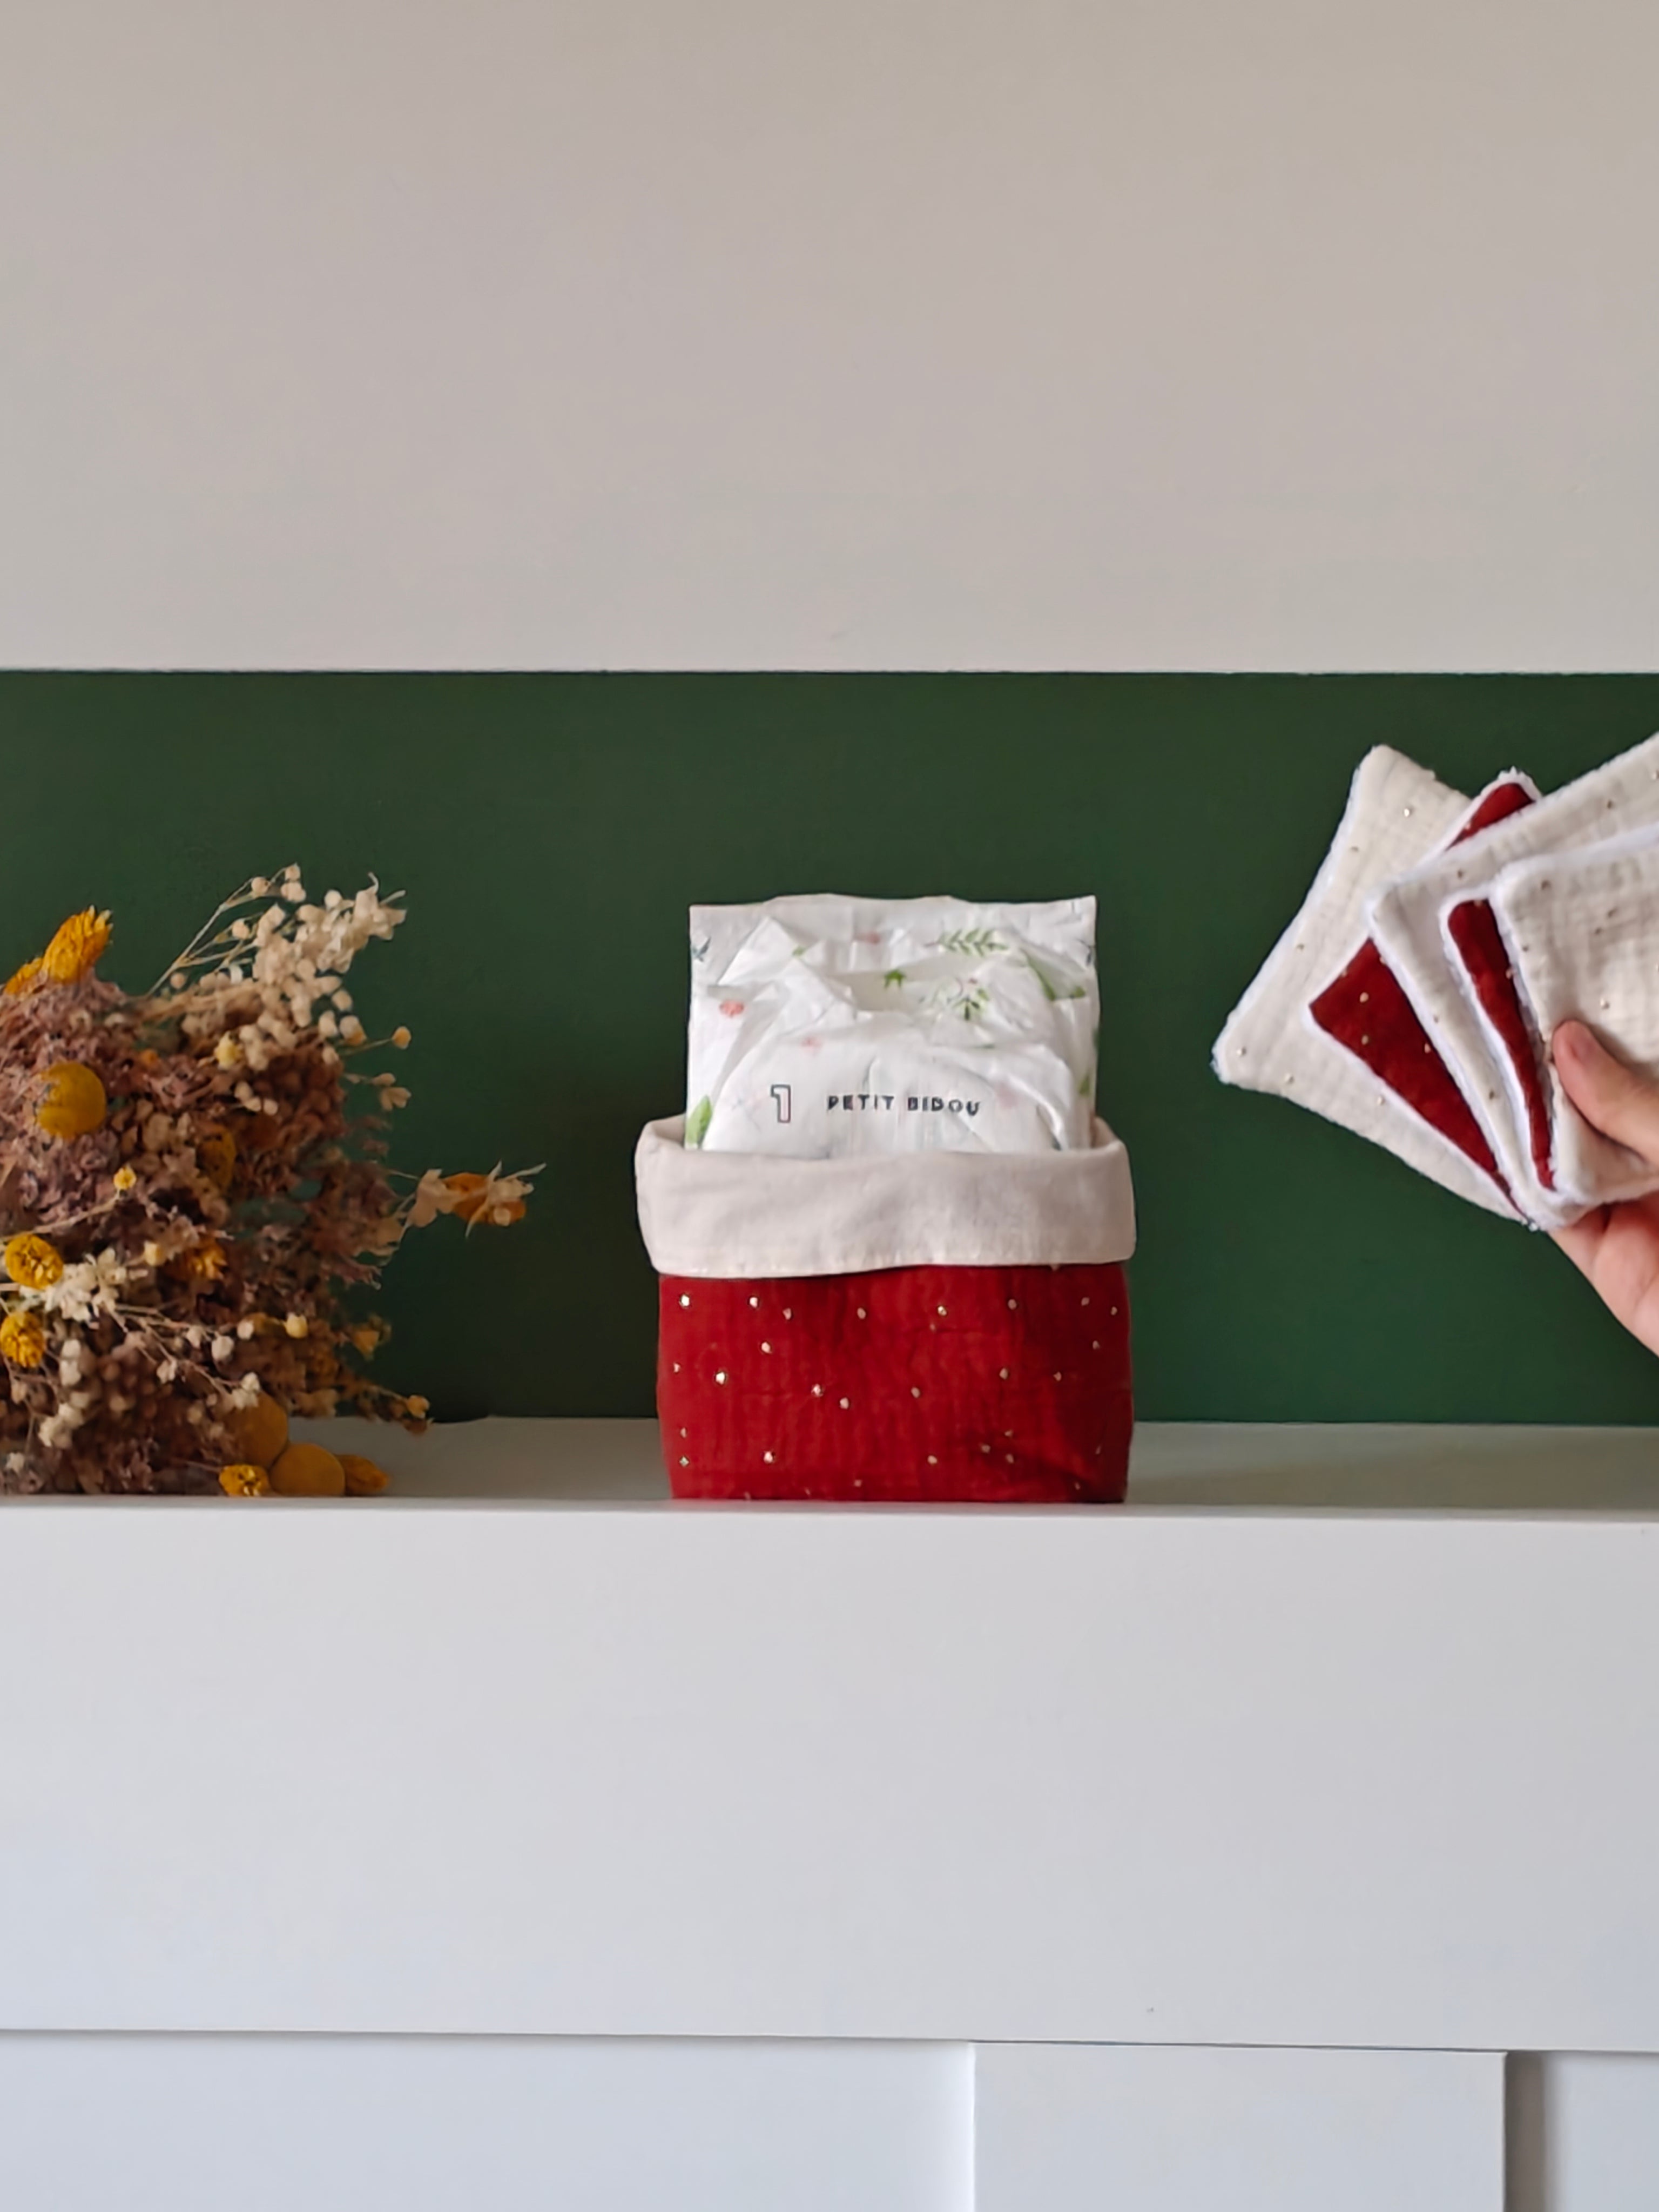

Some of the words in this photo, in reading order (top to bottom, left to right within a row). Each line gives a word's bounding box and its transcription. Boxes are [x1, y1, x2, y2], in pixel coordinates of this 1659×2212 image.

[770, 1084, 791, 1123] 1
[827, 1094, 894, 1111] PETIT
[907, 1096, 980, 1116] BIDOU
